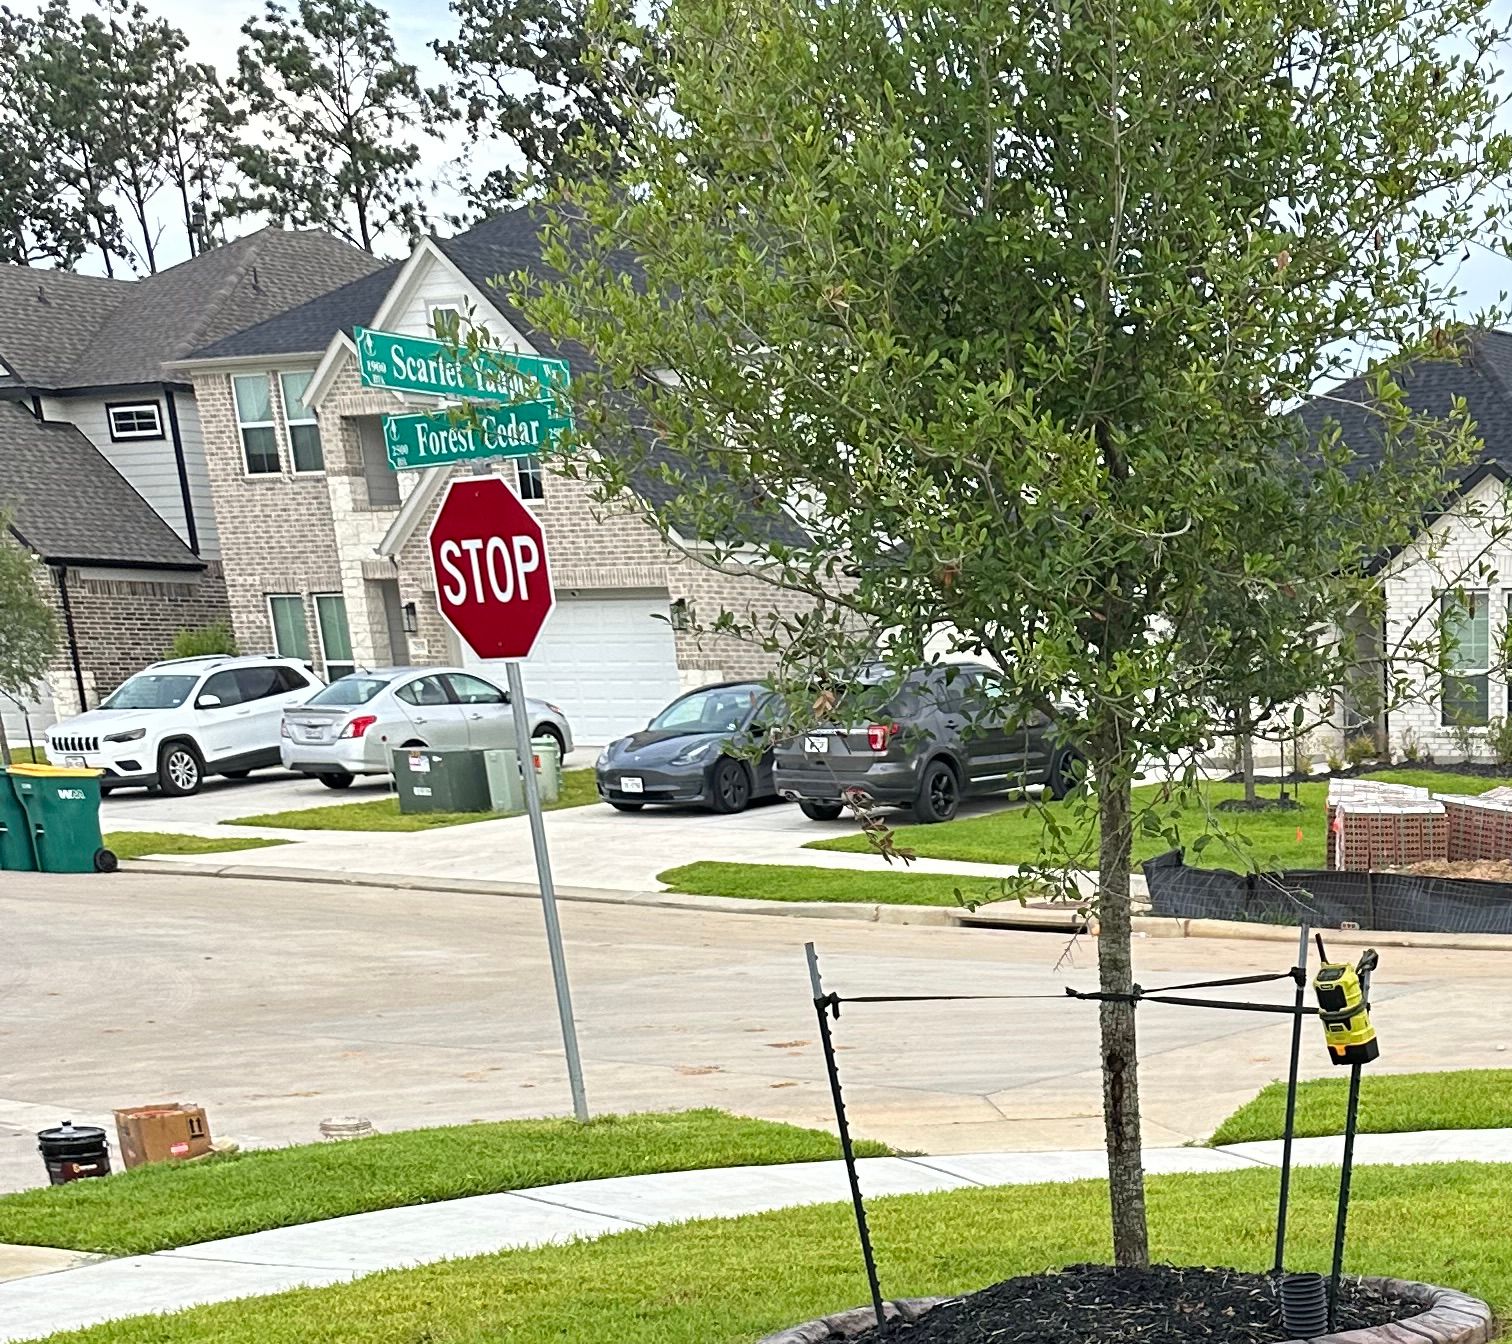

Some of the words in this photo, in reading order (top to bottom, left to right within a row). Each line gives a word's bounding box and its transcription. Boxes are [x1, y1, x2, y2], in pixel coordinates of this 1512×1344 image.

[391, 344, 465, 388] Scarlet
[414, 420, 476, 457] Forest
[481, 412, 540, 450] Cedar
[440, 535, 540, 606] STOP
